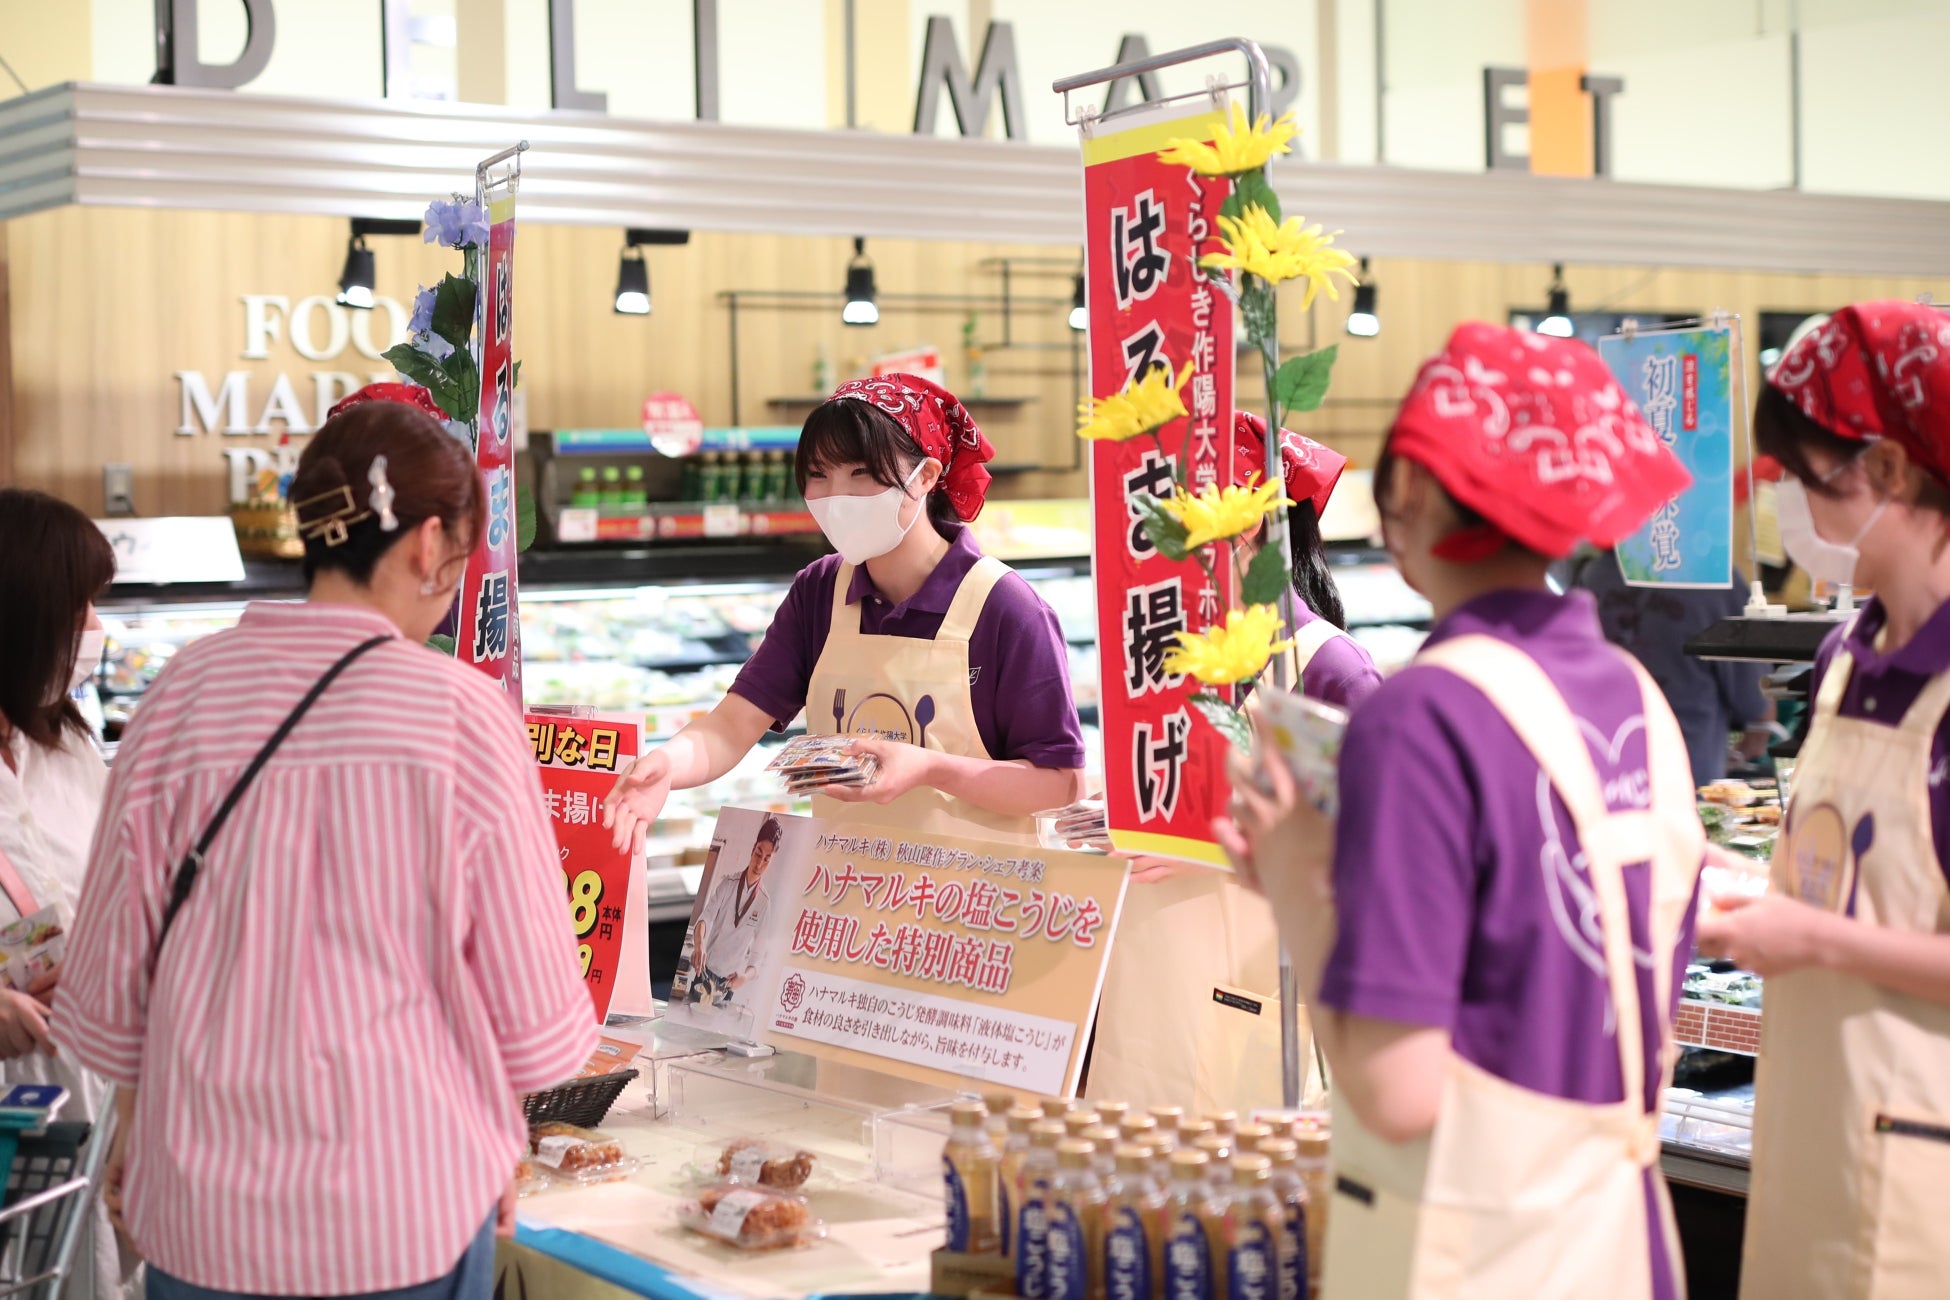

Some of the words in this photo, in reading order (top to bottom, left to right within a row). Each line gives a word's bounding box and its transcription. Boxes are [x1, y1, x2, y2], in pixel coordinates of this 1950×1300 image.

[599, 923, 613, 941] 円
[803, 864, 1104, 948] ハナマルキの塩こうじを
[590, 968, 603, 985] 円
[790, 907, 1015, 994] 使用した特別商品
[802, 1007, 1029, 1073] 食材の良さを引き出しながら、旨味を付与します。
[808, 985, 1067, 1053] ハナマルキ独自のこうじ発酵調味料「液体塩こうじ」が
